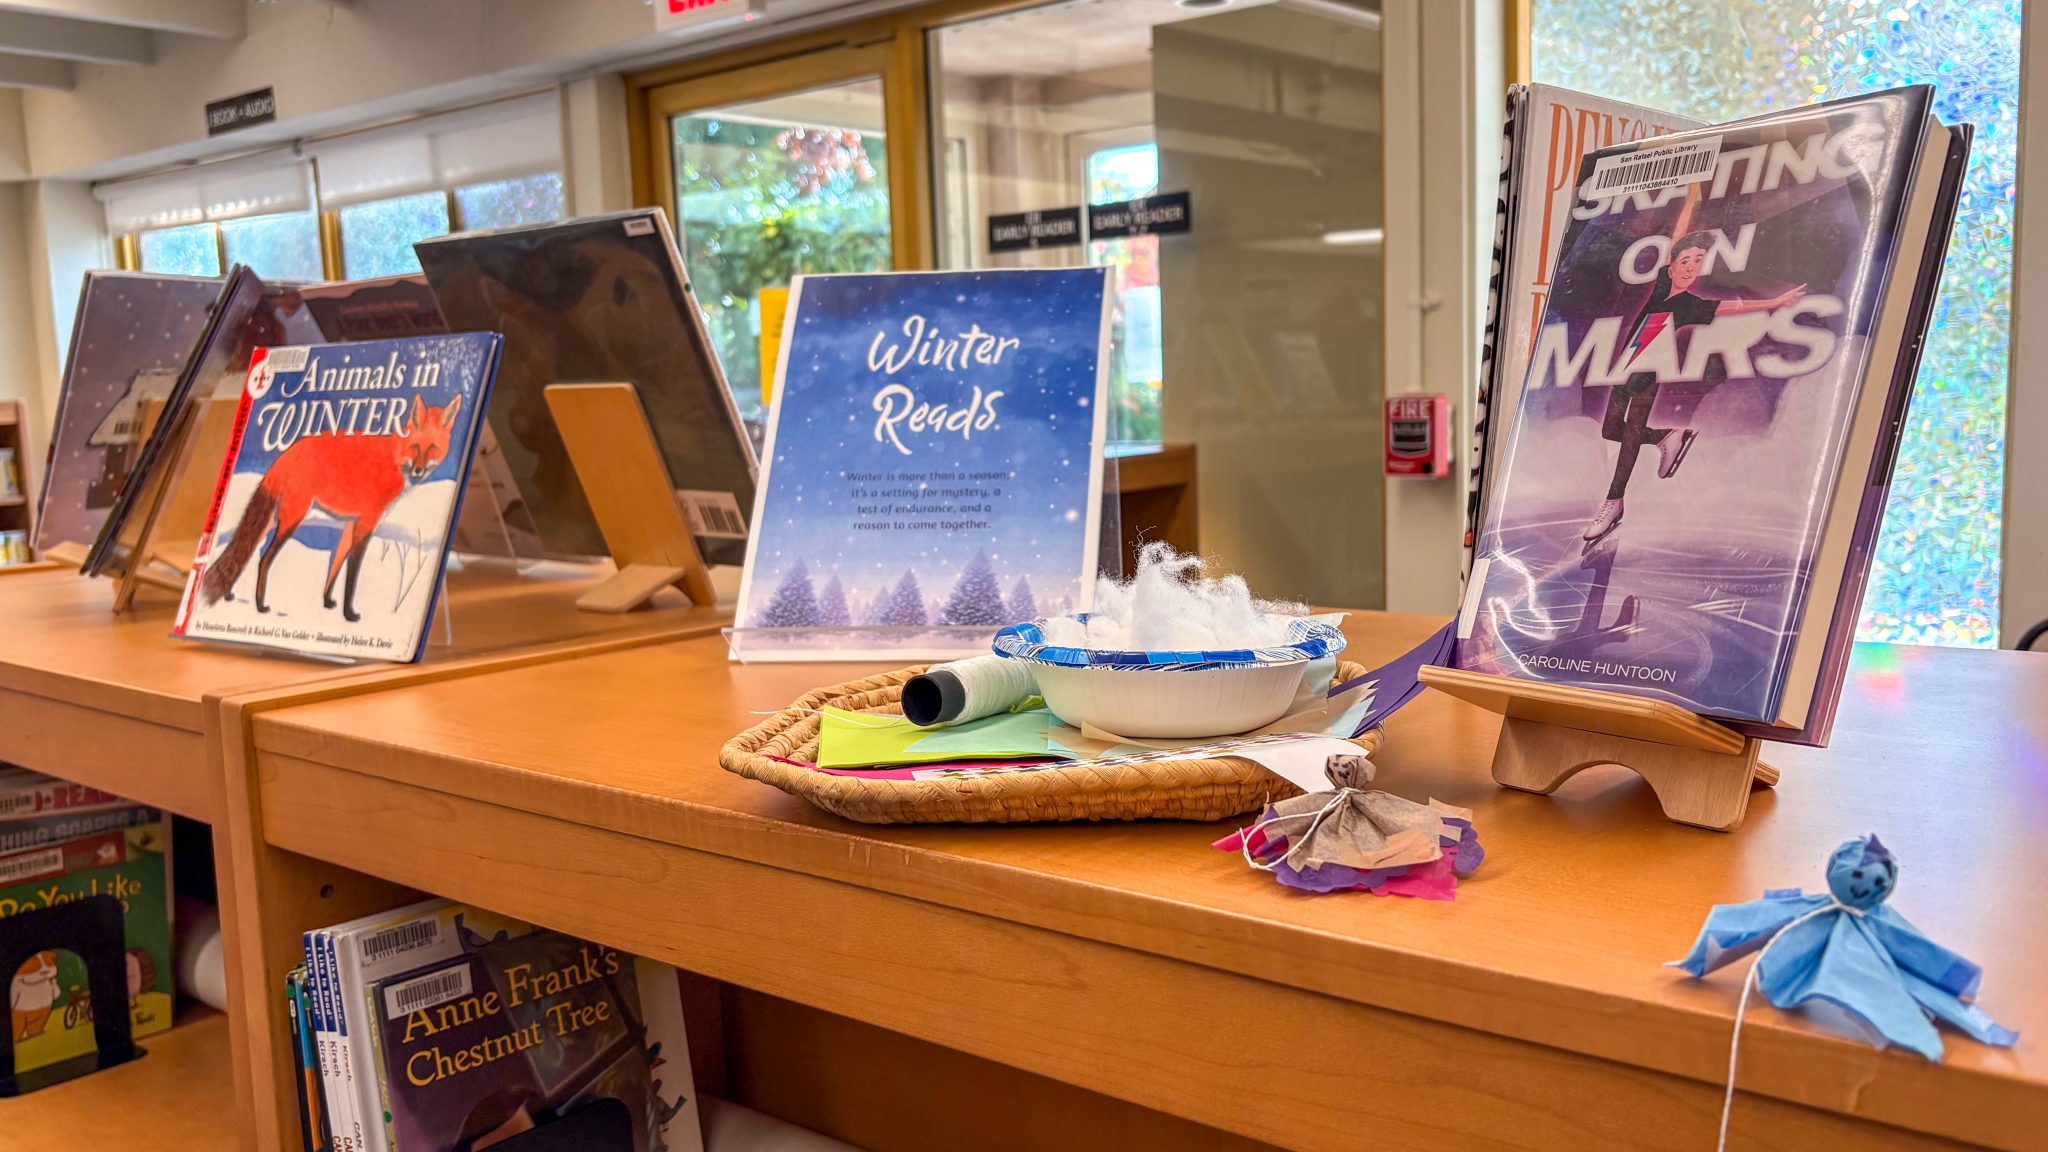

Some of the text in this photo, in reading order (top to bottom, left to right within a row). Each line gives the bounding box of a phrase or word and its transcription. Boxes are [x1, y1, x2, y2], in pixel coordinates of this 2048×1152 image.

[1633, 152, 1652, 161] Rafael
[1654, 149, 1673, 158] Public
[1674, 144, 1698, 153] Library
[993, 219, 1076, 242] EARLY READER
[1093, 205, 1185, 230] EARLY READER
[1618, 223, 1757, 284] ON
[867, 315, 1020, 375] Winter
[1528, 294, 1846, 390] MARS
[281, 351, 441, 397] Animals in
[872, 383, 1005, 456] Reads
[1389, 399, 1431, 417] FIRE
[258, 397, 411, 452] WINTER
[847, 472, 883, 482] Winter
[886, 472, 895, 482] is
[898, 474, 926, 482] more
[930, 472, 955, 481] than
[851, 488, 867, 498] it's
[871, 490, 878, 498] a
[881, 488, 919, 500] setting
[921, 487, 938, 500] for
[941, 488, 990, 500] mystery,
[857, 503, 992, 516] test of endurance, and a
[853, 520, 991, 533] reason to come together.
[195, 620, 202, 630] by
[254, 626, 274, 637] Richard
[343, 635, 350, 647] by
[351, 635, 368, 647] Helen
[1518, 653, 1677, 683] CAROLINE HUNTOON
[306, 953, 314, 975] Like
[318, 953, 326, 975] Like
[402, 947, 620, 1044] Anne Frank's
[319, 1040, 329, 1078] Kirsch
[406, 1019, 544, 1088] Chestnut
[546, 1000, 611, 1037] Tree
[330, 1041, 341, 1078] Kirsch
[343, 1045, 352, 1082] Kirsch
